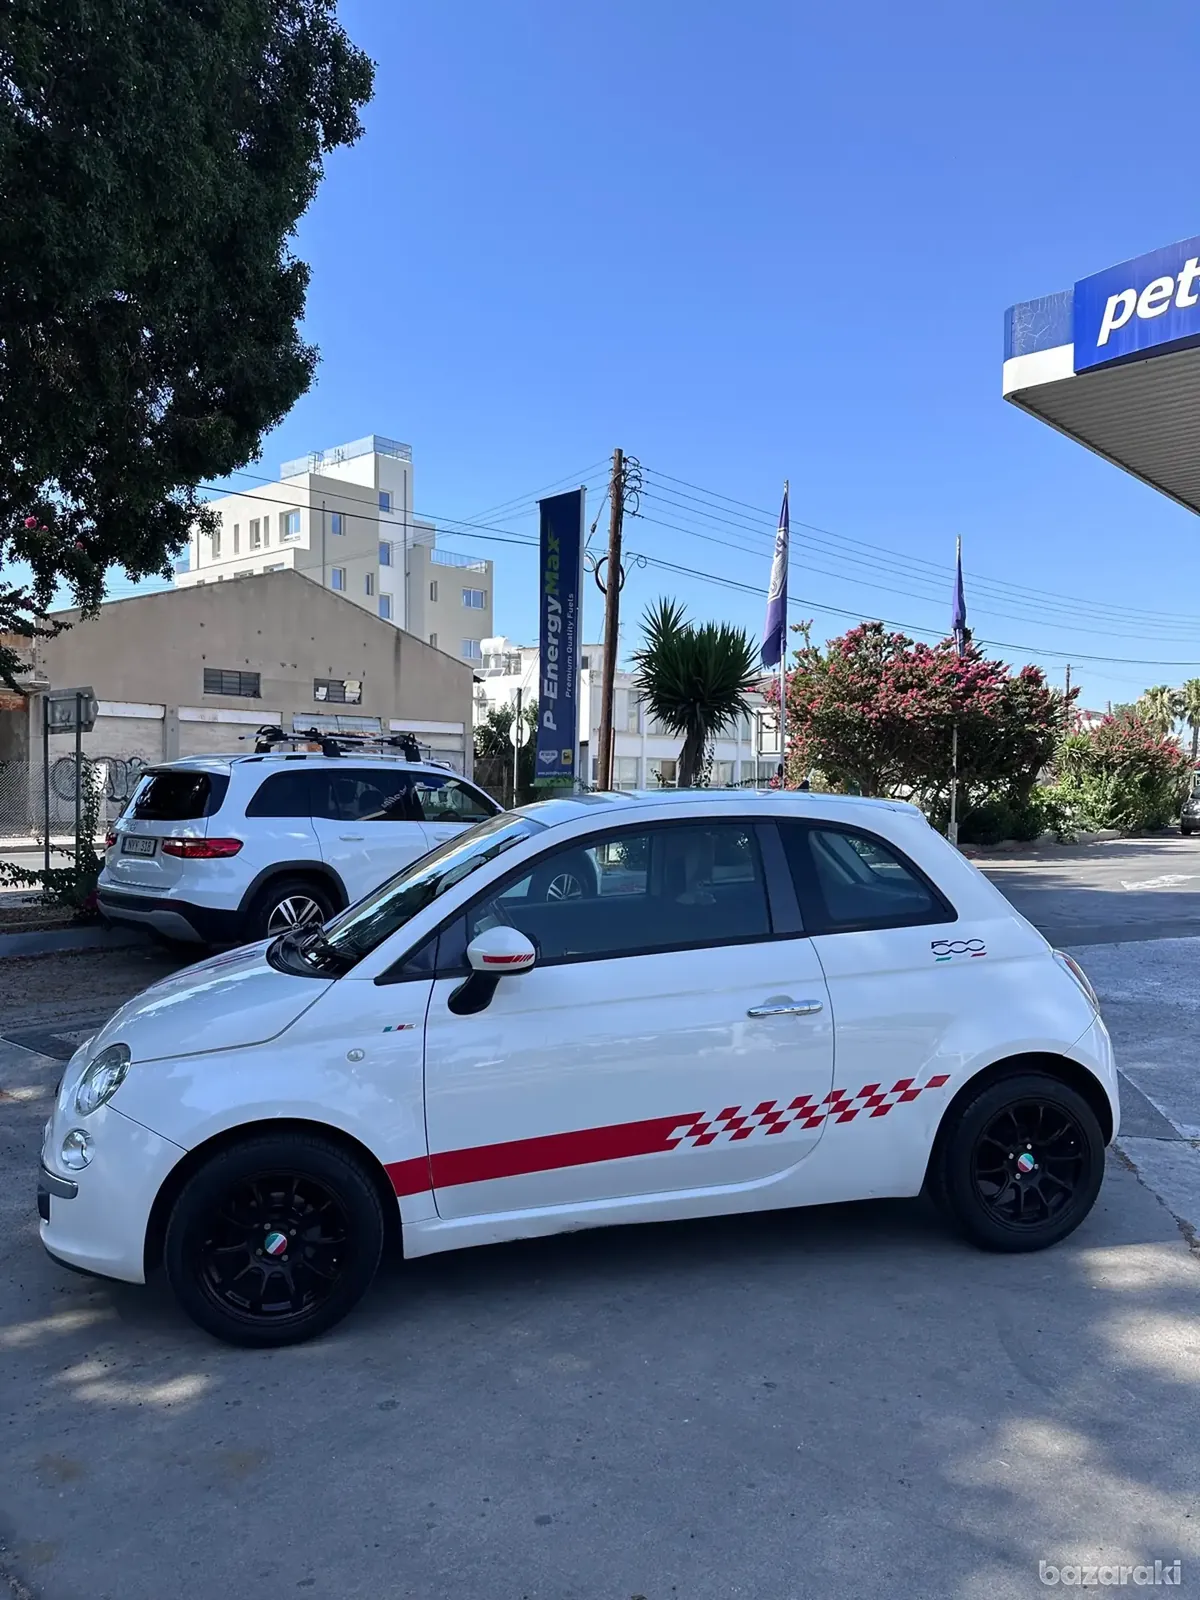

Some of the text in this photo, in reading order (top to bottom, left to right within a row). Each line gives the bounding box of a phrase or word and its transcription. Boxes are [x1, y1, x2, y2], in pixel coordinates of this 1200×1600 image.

[566, 621, 575, 654] Quality
[565, 655, 573, 698] Premium
[931, 938, 986, 956] 500
